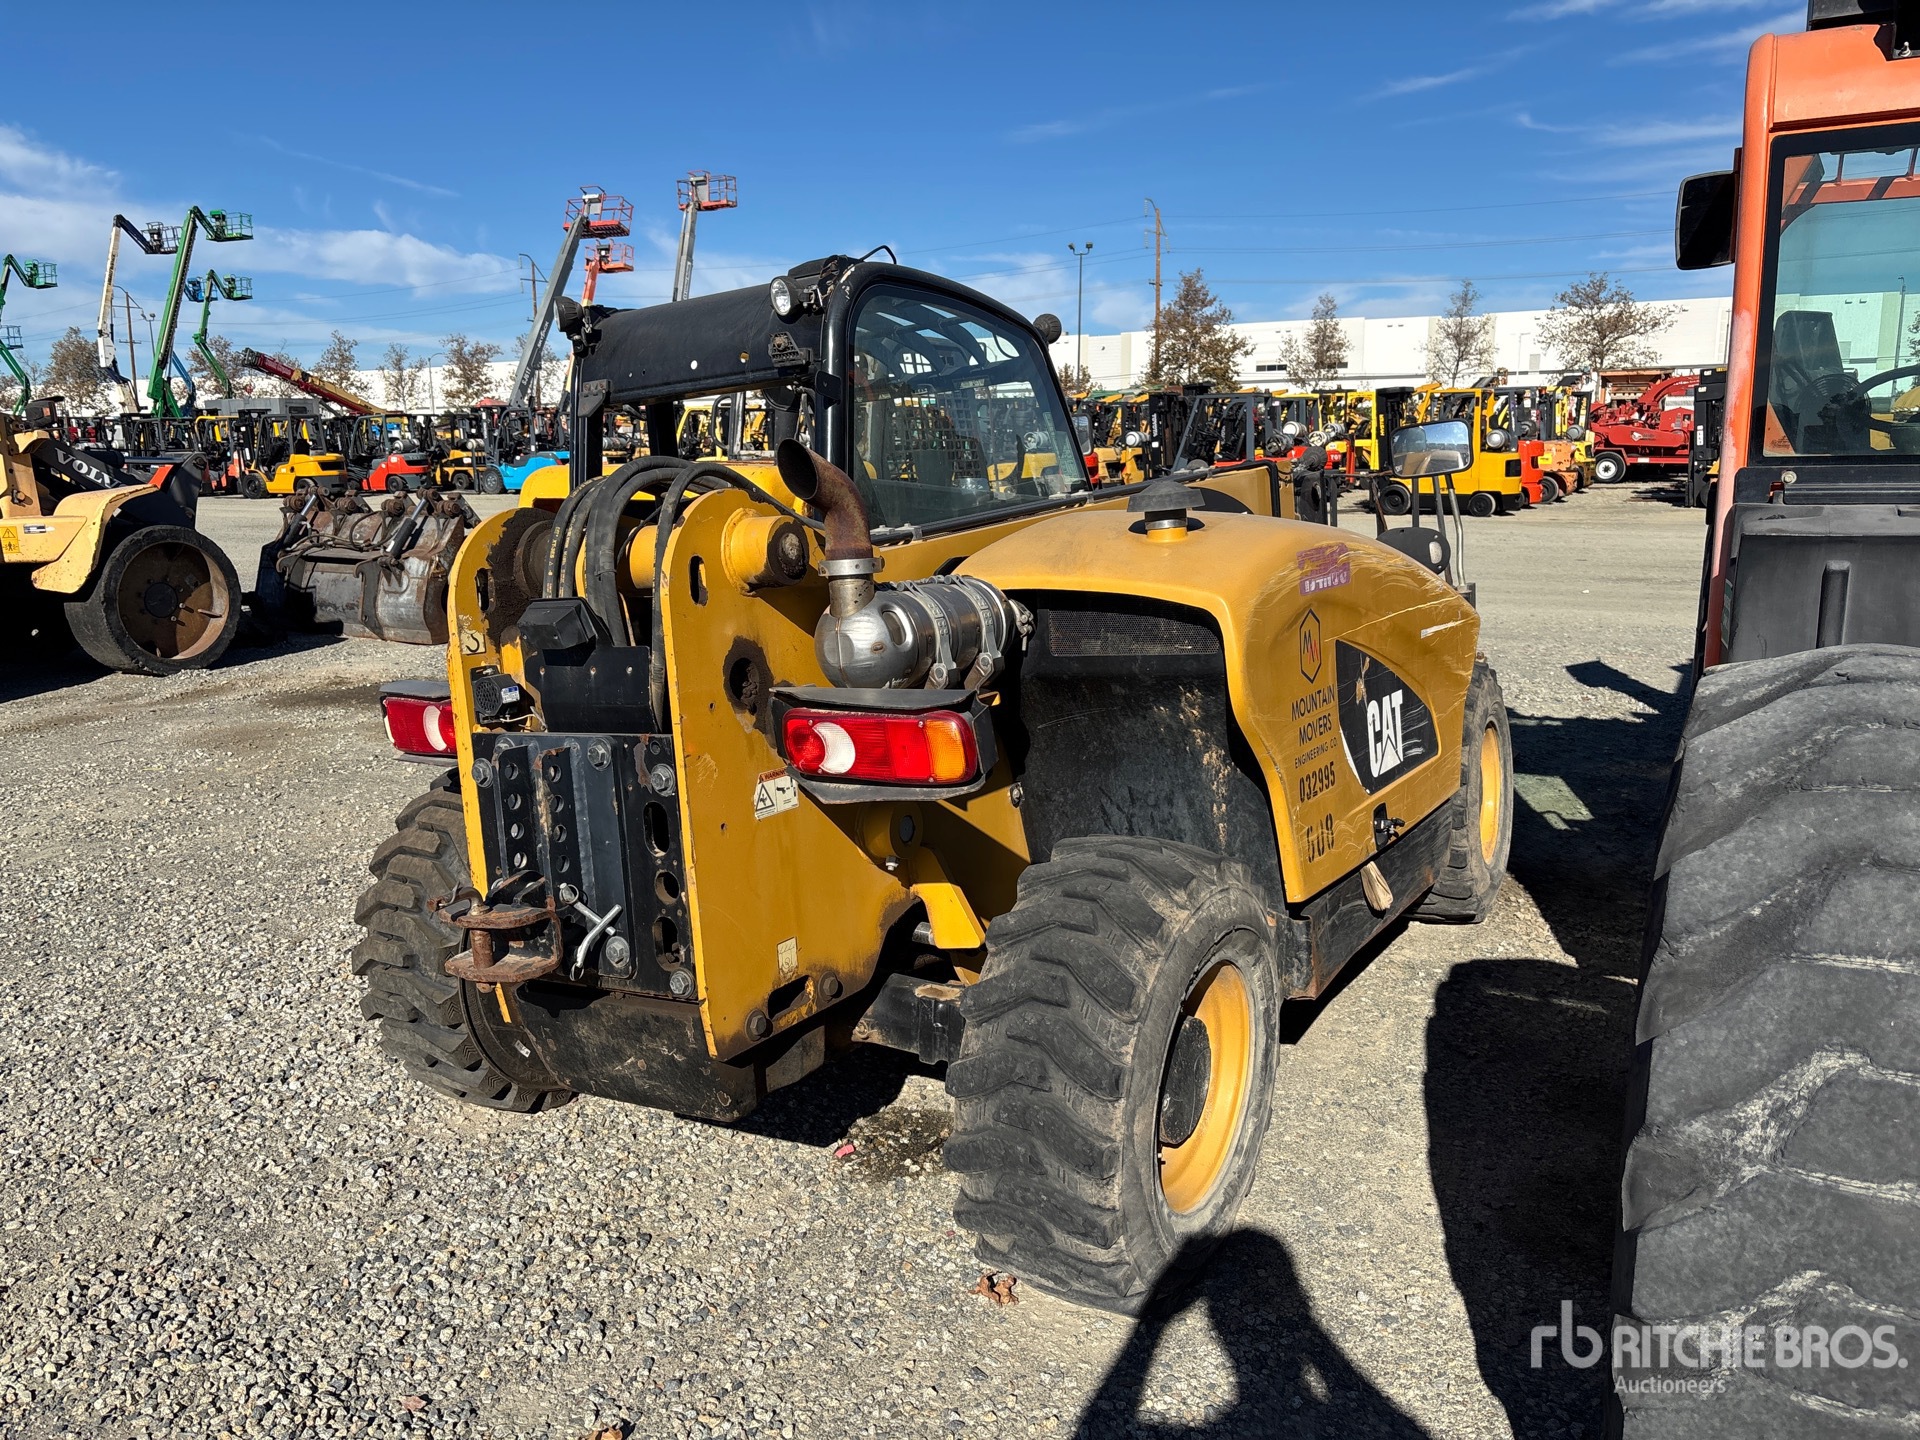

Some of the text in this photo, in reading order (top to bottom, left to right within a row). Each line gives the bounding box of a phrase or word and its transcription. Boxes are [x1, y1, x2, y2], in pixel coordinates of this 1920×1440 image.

[55, 447, 127, 489] VOLV
[1291, 684, 1335, 721] MOUNTAIN
[1299, 713, 1332, 746] MOVERS
[1367, 689, 1403, 778] CAT
[1294, 741, 1329, 769] ENGINEERING
[1299, 761, 1336, 803] 032995
